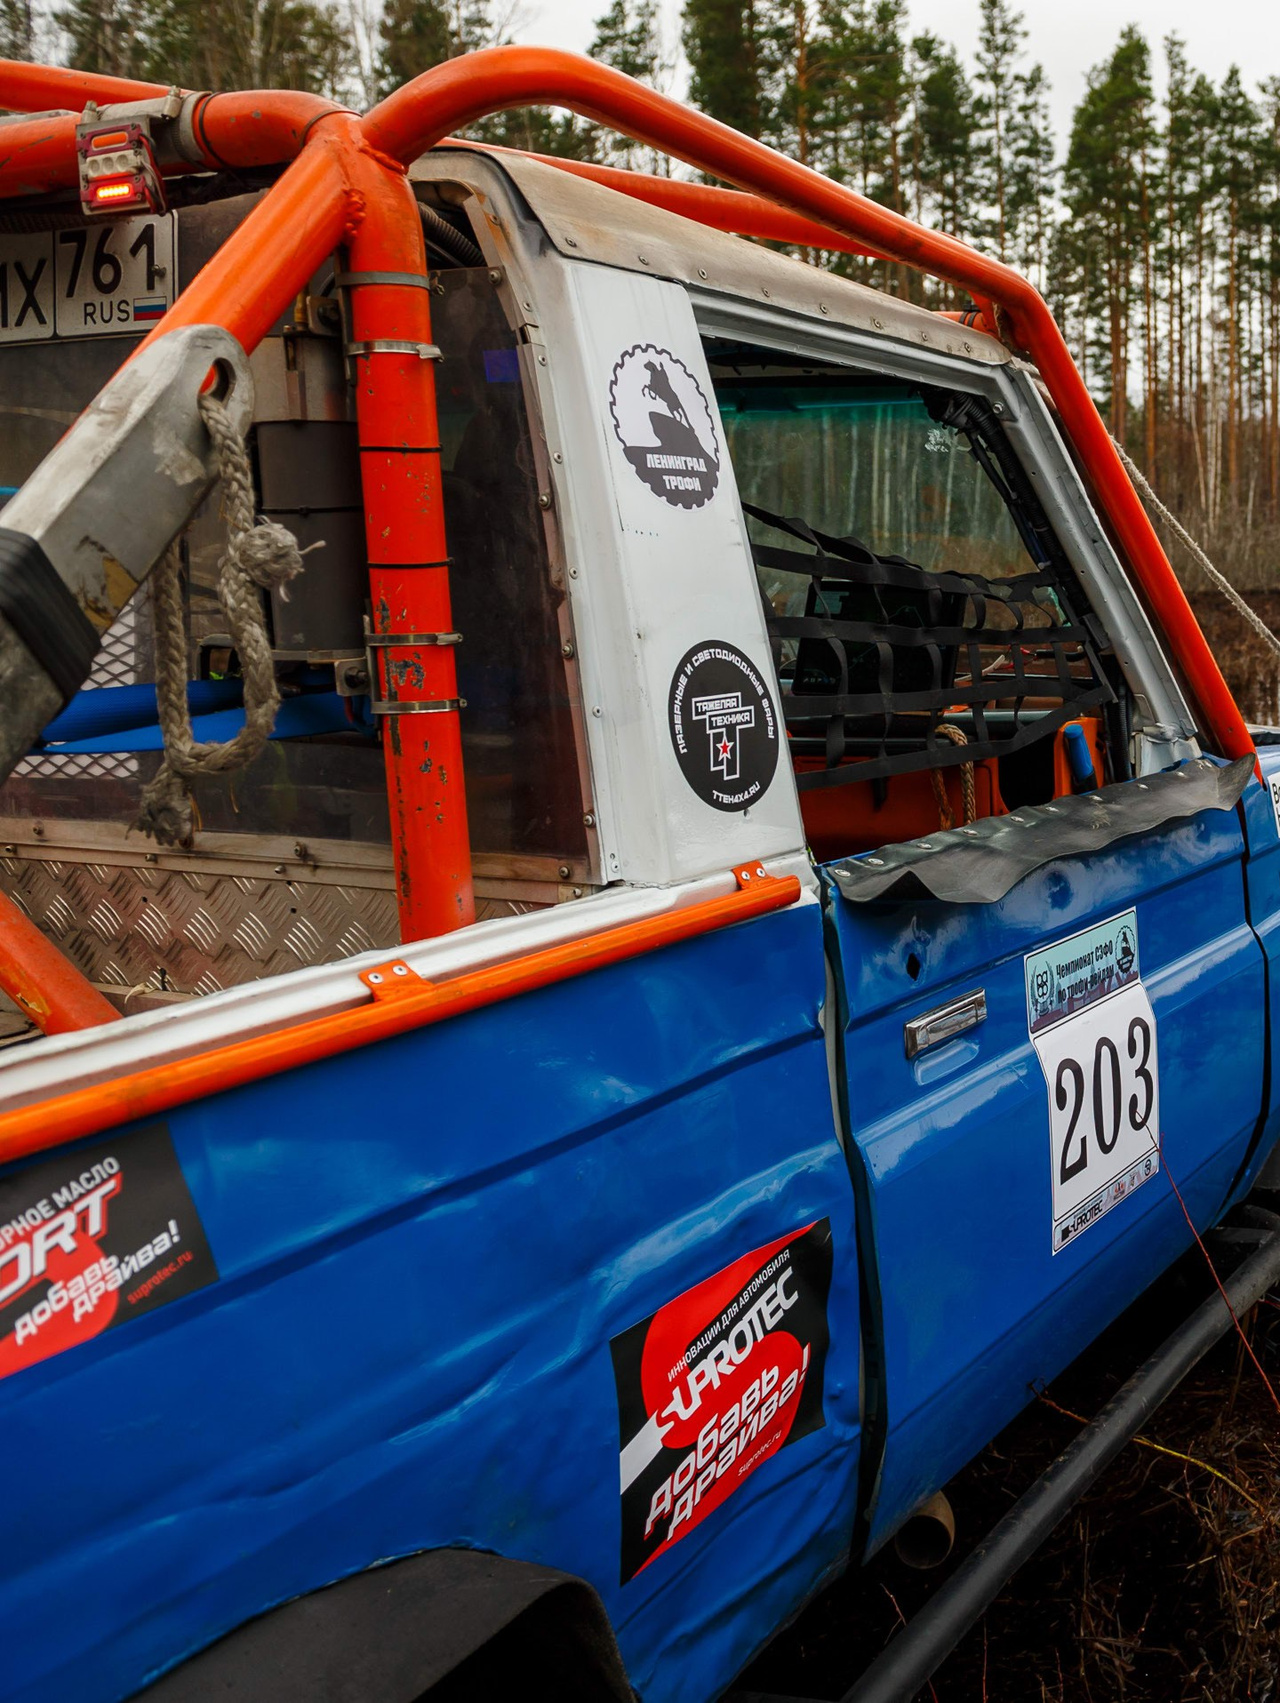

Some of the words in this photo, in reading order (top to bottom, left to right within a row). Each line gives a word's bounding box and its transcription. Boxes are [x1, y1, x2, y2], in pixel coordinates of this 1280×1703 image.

[59, 223, 155, 298] 761
[83, 300, 130, 325] RUS
[646, 454, 708, 472] ЛЕНИНГРАД
[662, 475, 702, 491] ТРОФИ
[673, 674, 688, 754] ЛАЗЕРНЫЕ
[685, 663, 694, 676] И
[692, 648, 764, 696] СВЕТОДИОДНЫЕ
[761, 698, 775, 739] ФАРЫ
[695, 697, 738, 712] ТЯЖЕЛАЯ
[710, 711, 750, 727] ТЕХНИКА
[1056, 951, 1094, 979] Чемпионат
[1055, 1017, 1154, 1186] 203
[51, 1156, 120, 1209] МАСЛО
[14, 1254, 120, 1346] добавь
[72, 1219, 181, 1323] драйва!
[127, 1250, 194, 1305] suprotec.ru
[660, 1266, 799, 1432] SUPROTEC
[667, 1321, 721, 1382] ИННОВАЦИИ
[720, 1302, 740, 1329] ДЛЯ
[739, 1249, 791, 1309] АВТОМОБИЛЯ
[644, 1364, 780, 1537] добавь
[666, 1342, 811, 1542] драйва!
